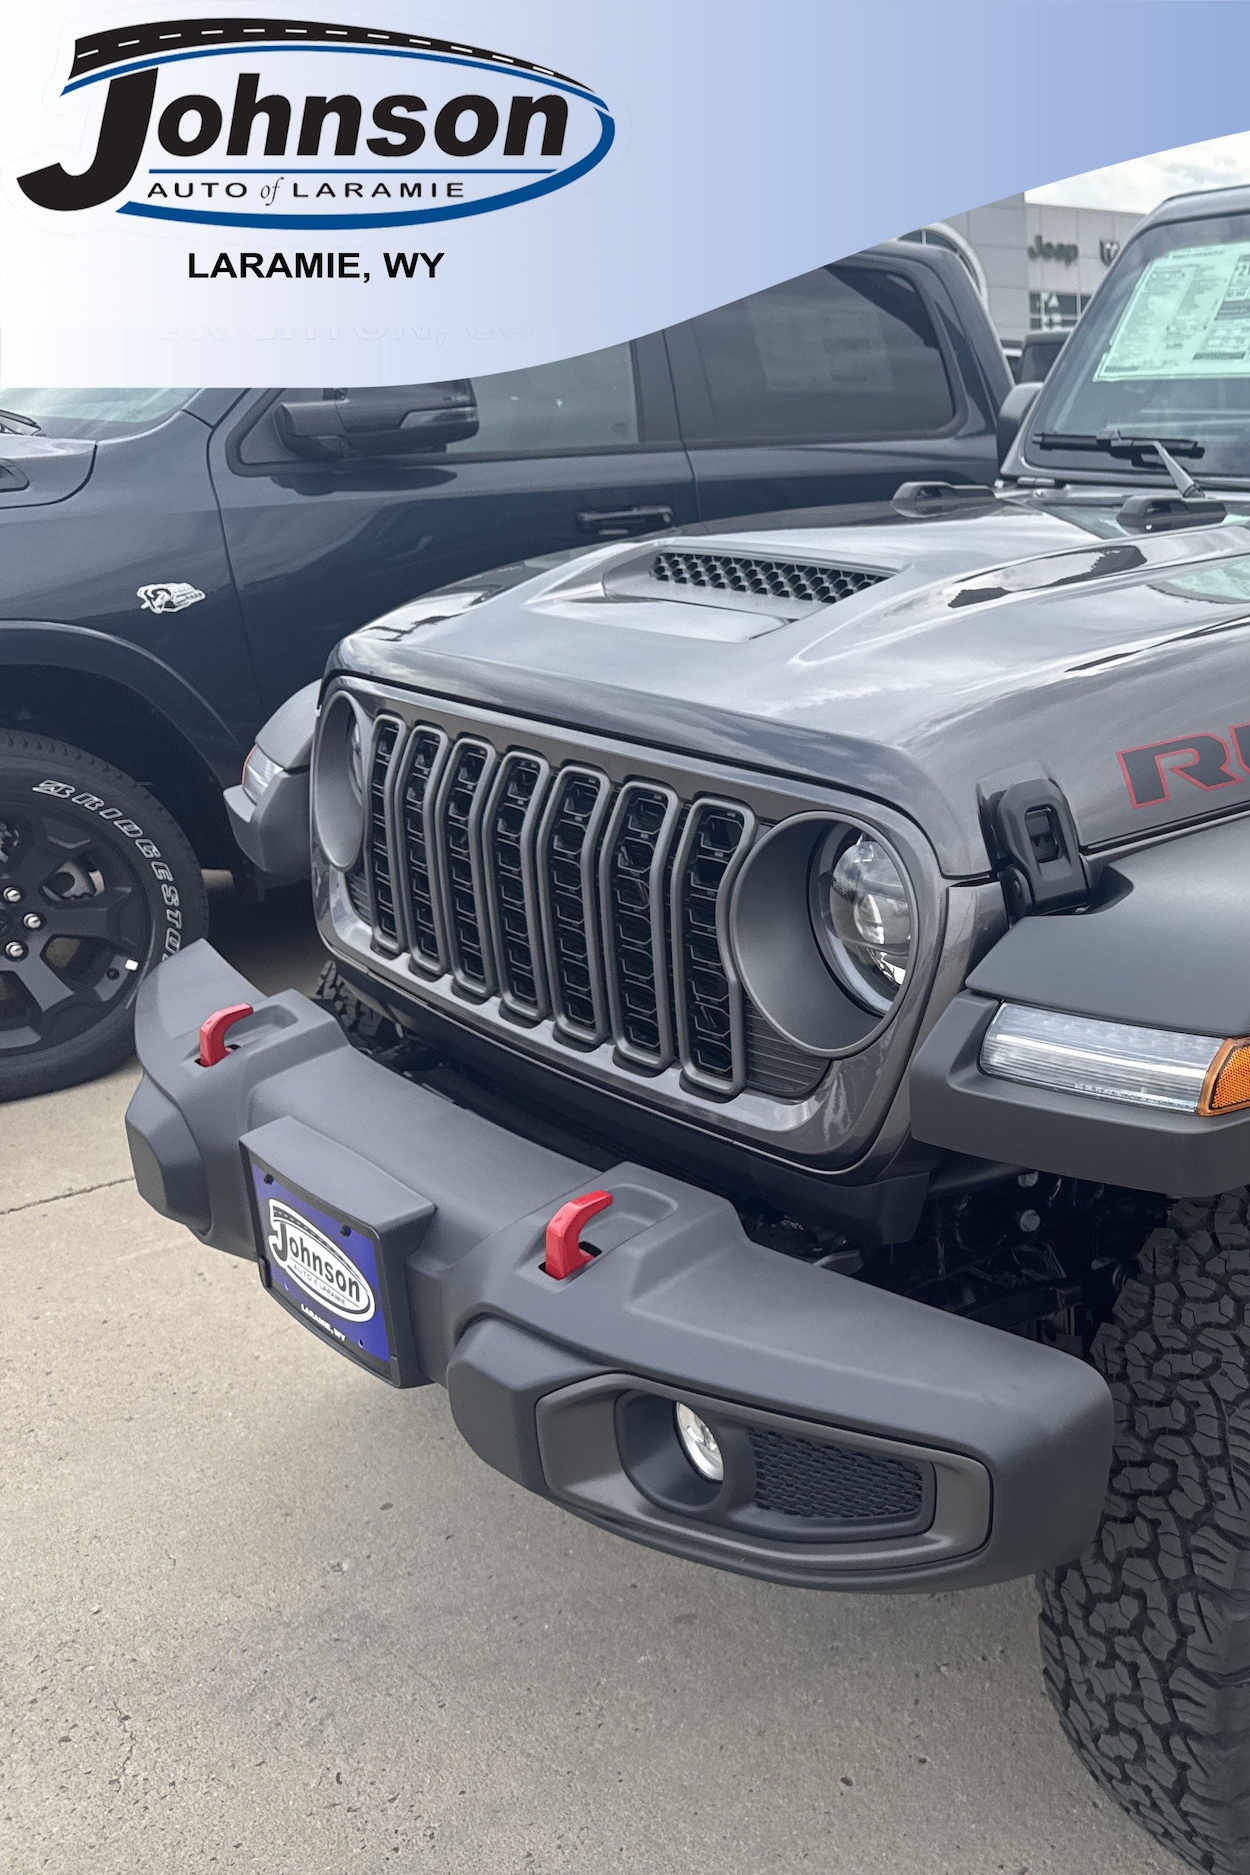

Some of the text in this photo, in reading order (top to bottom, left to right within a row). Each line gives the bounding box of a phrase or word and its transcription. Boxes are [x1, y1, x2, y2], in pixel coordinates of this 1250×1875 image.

[1028, 235, 1079, 267] Jeep
[32, 779, 183, 962] BRIDGESTO
[272, 1222, 361, 1302] Johnson
[294, 1264, 312, 1281] AUTO
